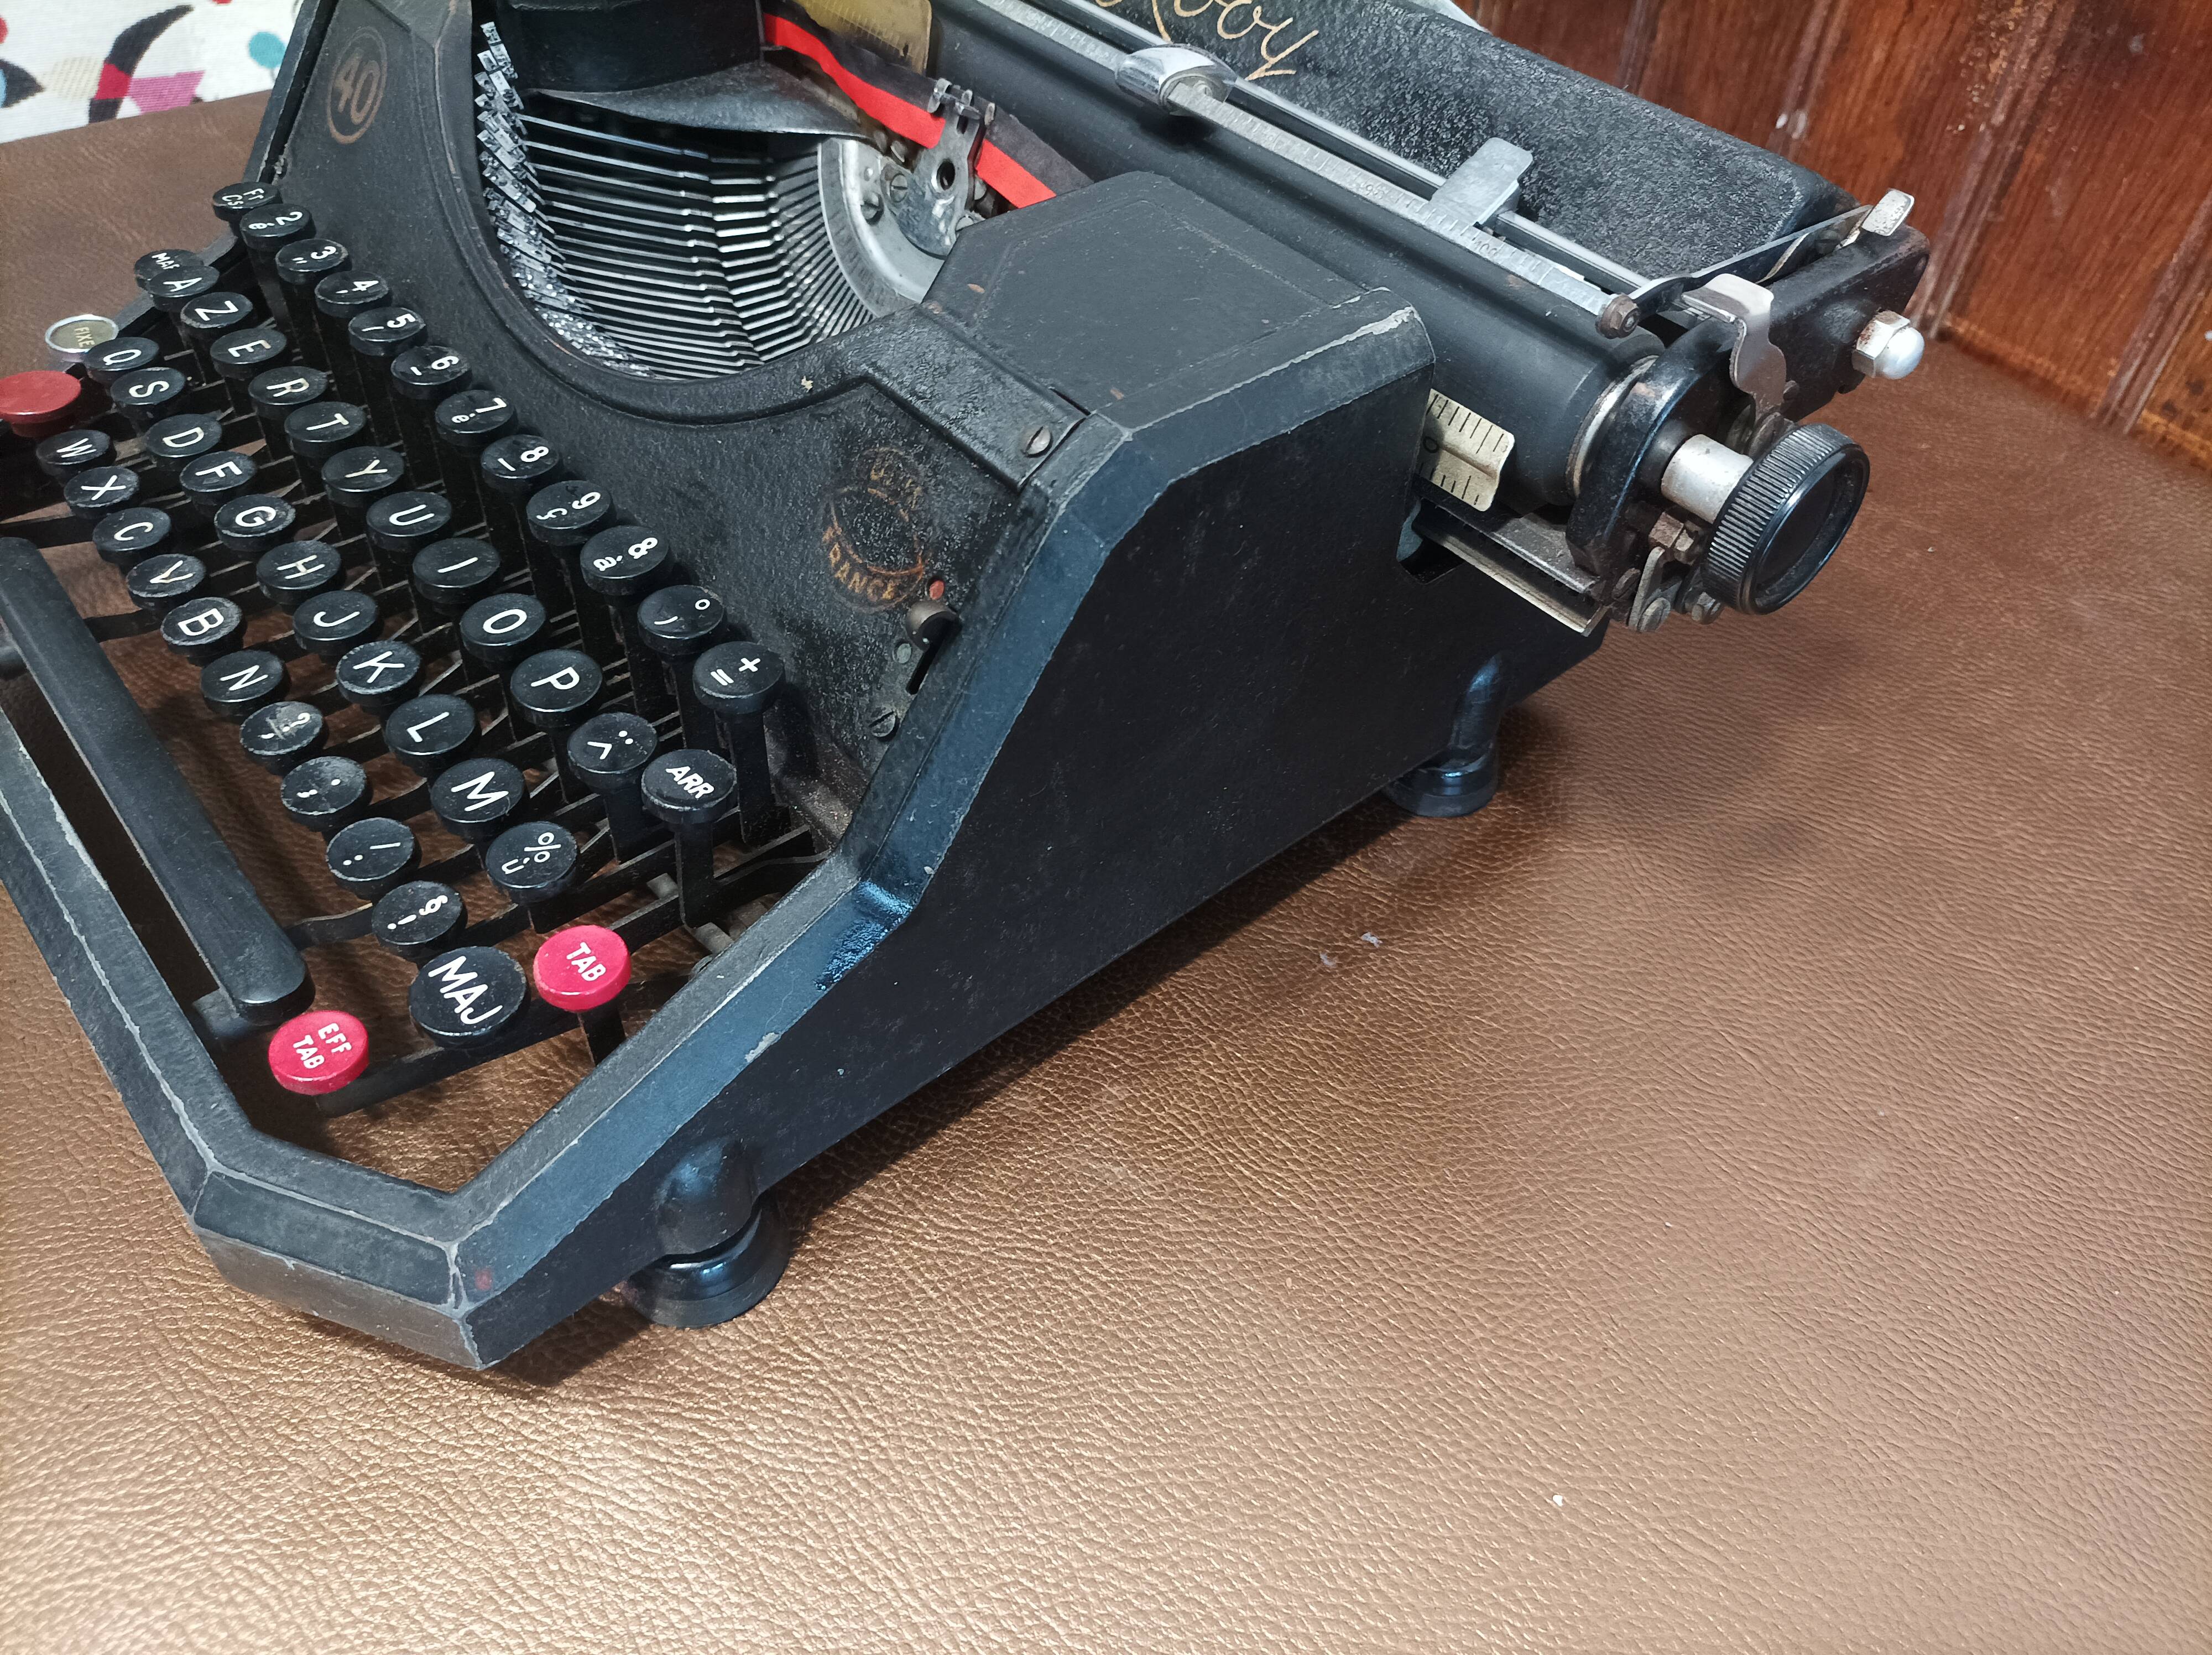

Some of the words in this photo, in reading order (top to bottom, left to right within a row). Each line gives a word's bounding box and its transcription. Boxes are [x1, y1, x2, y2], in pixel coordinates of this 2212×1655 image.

[333, 49, 381, 125] 40
[275, 211, 303, 226] 2
[310, 246, 337, 259] 3
[163, 277, 202, 292] A
[352, 280, 379, 292] 4
[194, 300, 239, 321] Z
[387, 313, 416, 328] 5
[74, 326, 96, 350] FIXE
[228, 340, 272, 357] E
[102, 349, 142, 366] Q
[431, 355, 460, 370] 6
[128, 381, 170, 398] S
[266, 378, 310, 397] R
[475, 397, 507, 413] 7
[306, 413, 349, 431] T
[162, 426, 205, 447] D
[56, 438, 97, 458] W
[520, 446, 549, 462] 8
[195, 461, 243, 478] F
[345, 459, 388, 478] Y
[81, 475, 127, 501] X
[571, 492, 601, 509] 9
[235, 506, 279, 527] G
[389, 504, 435, 526] U
[113, 522, 154, 541] C
[149, 560, 196, 584] V
[276, 554, 325, 579] H
[437, 556, 478, 573] I
[177, 608, 225, 636] B
[313, 611, 360, 627] J
[482, 608, 528, 634] O
[353, 650, 405, 683] K
[220, 664, 268, 691] N
[530, 667, 580, 690] P
[406, 711, 450, 742] L
[451, 771, 509, 811] M
[665, 766, 714, 799] ARR
[524, 832, 561, 863] %
[566, 941, 606, 981] TAB
[428, 955, 503, 1024] MAJ
[317, 1023, 352, 1053] EFF
[293, 1034, 325, 1069] TAB
